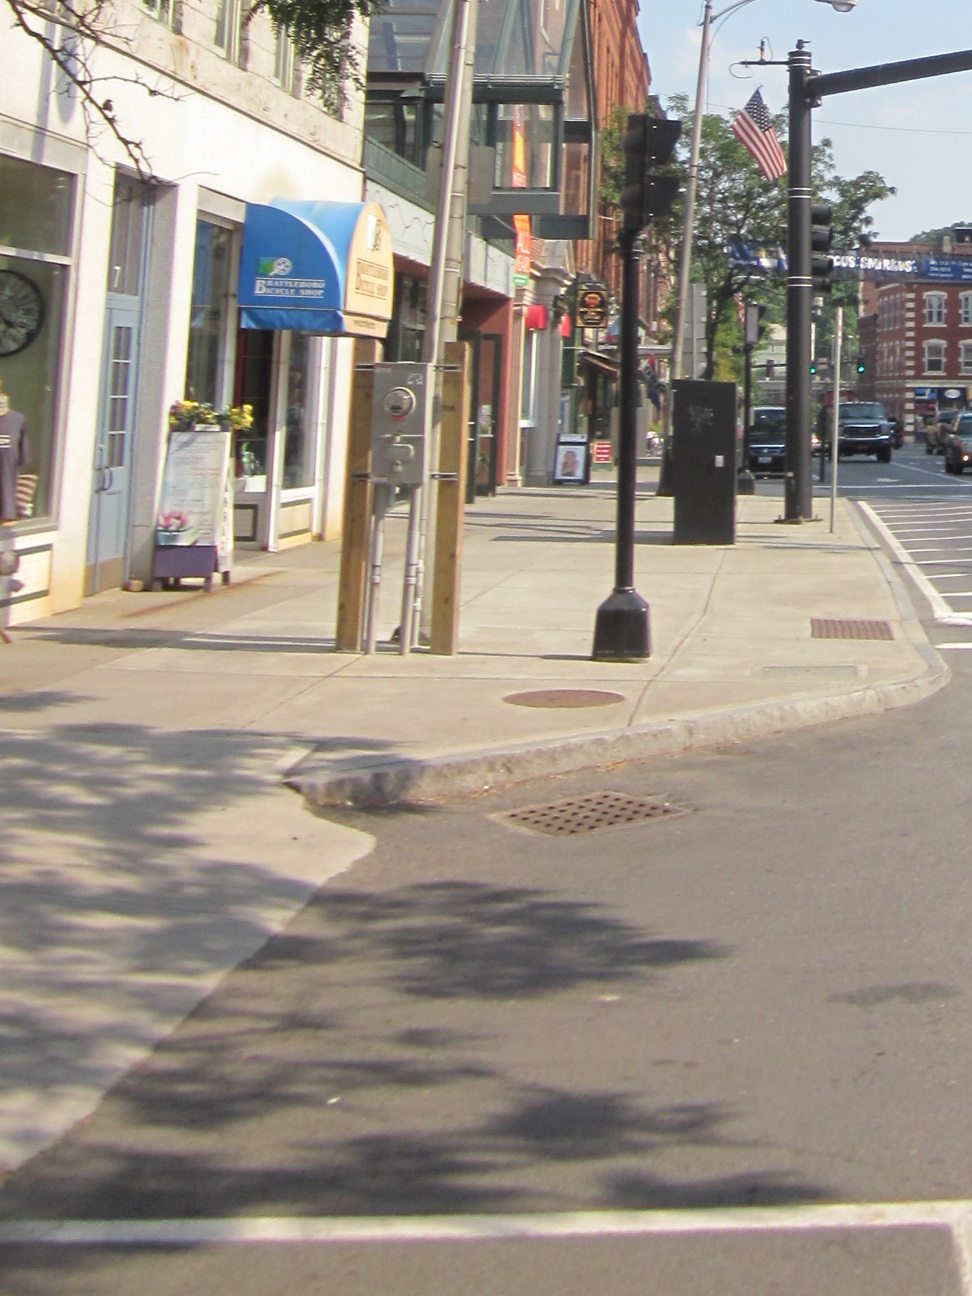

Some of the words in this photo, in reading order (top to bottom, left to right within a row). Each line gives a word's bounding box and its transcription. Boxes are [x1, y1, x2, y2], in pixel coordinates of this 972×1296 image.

[113, 265, 121, 288] 7
[255, 279, 325, 291] BRATTLEBORO
[255, 284, 297, 296] BICYCLE
[299, 288, 324, 296] SHOP
